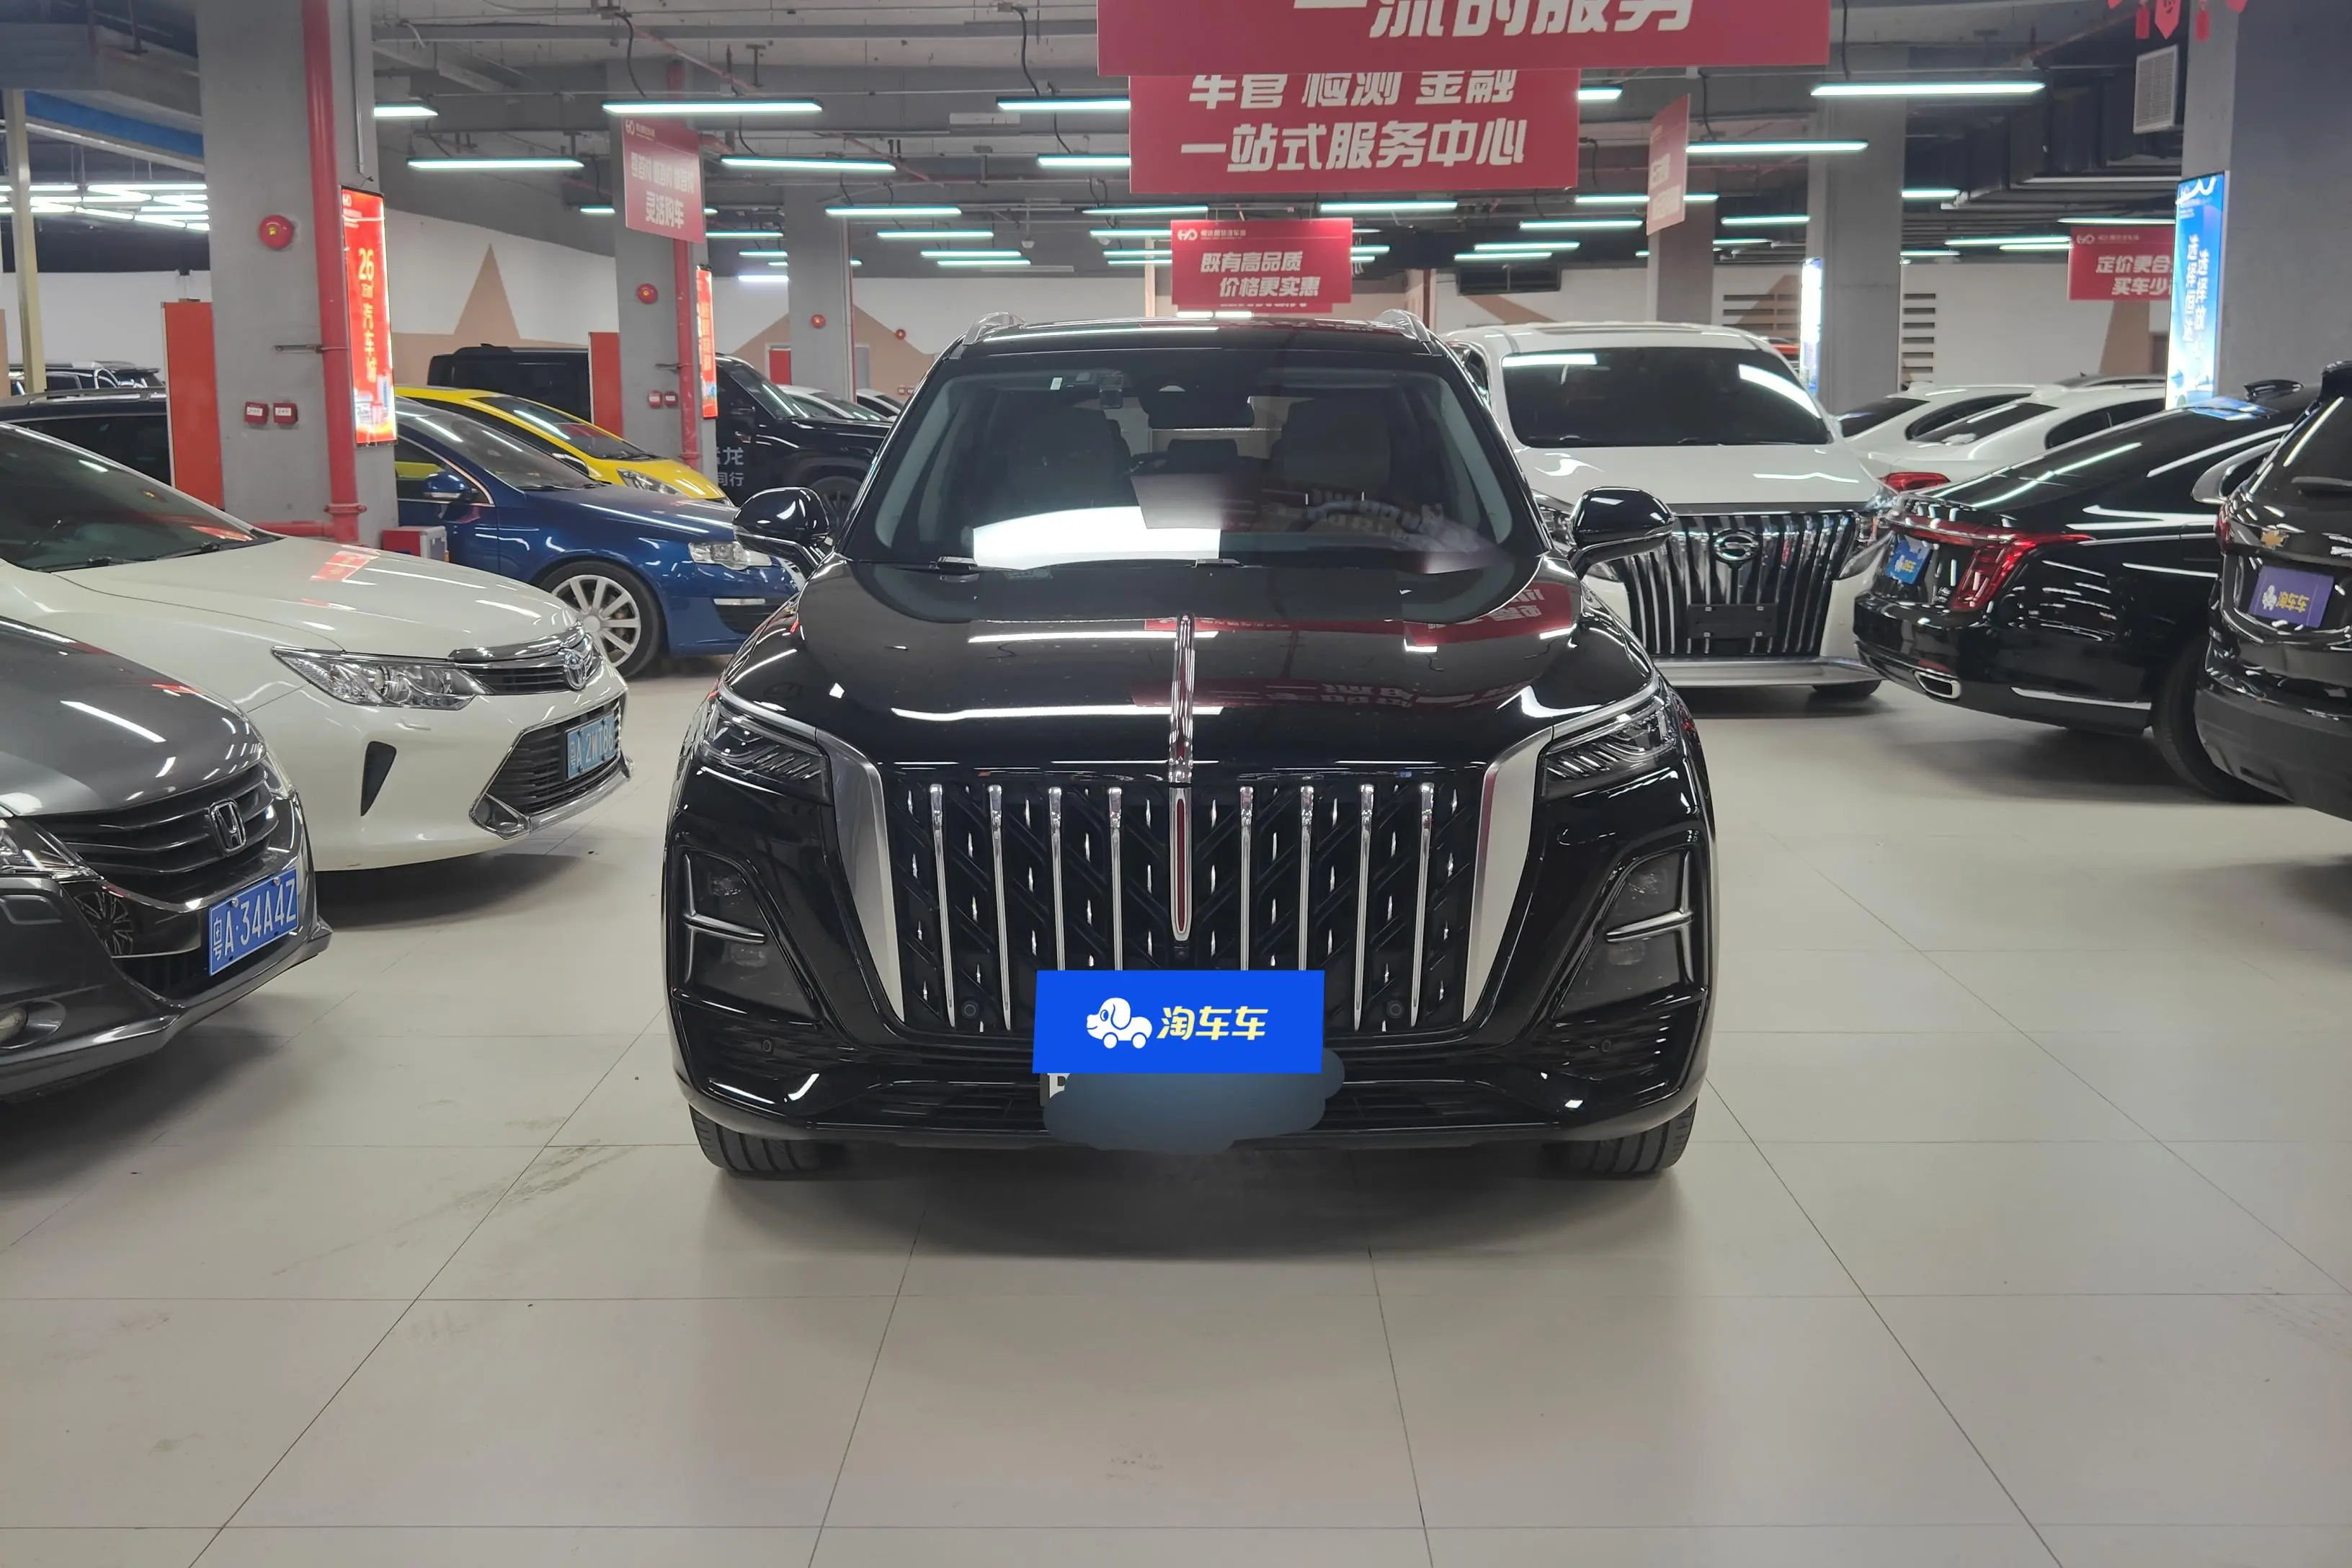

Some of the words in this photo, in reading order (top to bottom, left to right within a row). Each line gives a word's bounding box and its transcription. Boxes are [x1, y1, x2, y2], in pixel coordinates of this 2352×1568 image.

[1181, 117, 1528, 172] 一站式服务中心
[645, 190, 684, 229] 灵活购车
[1200, 251, 1304, 273] 既有高品质
[2095, 254, 2173, 274] 定价更合
[1219, 275, 1321, 298] 价格更实惠
[2111, 277, 2172, 295] 买车少
[717, 447, 744, 466] 龙
